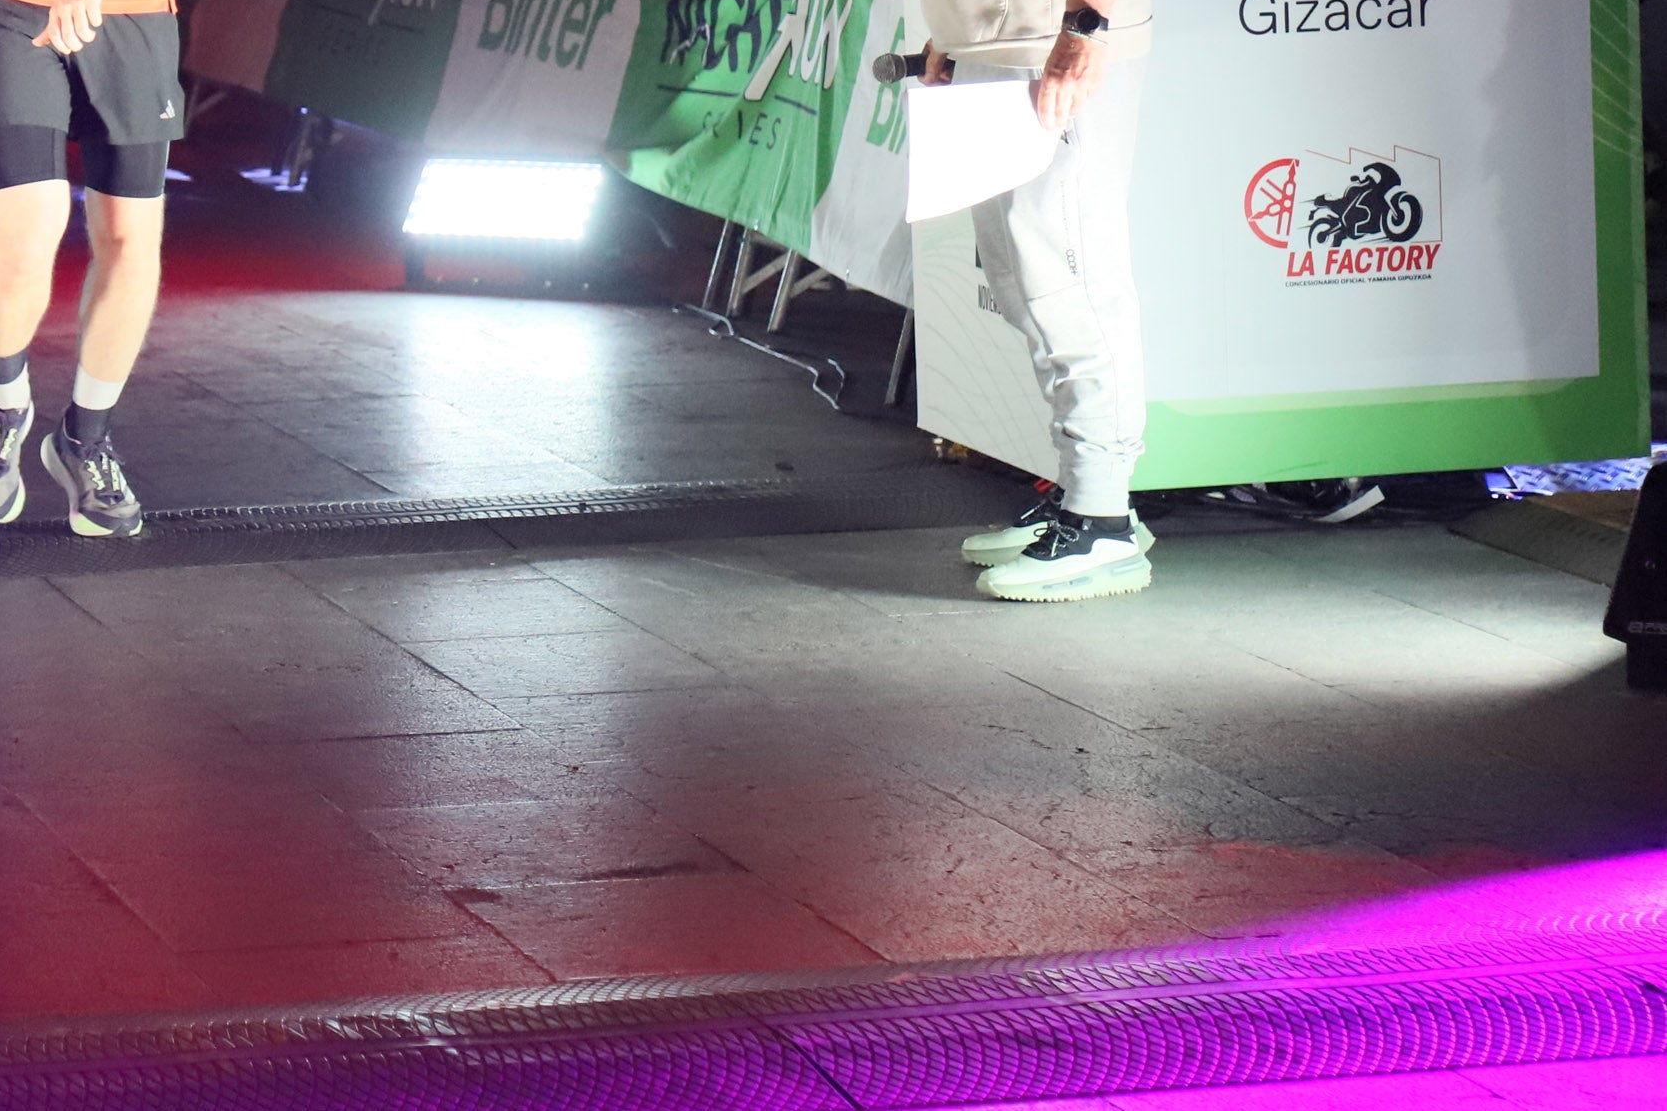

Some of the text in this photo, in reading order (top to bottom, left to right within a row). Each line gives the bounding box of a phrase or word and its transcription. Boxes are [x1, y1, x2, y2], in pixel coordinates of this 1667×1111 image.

[1287, 243, 1442, 277] LA FACTORY
[1285, 278, 1340, 288] CONCESIONARIO
[1341, 277, 1366, 285] OFICIAL
[1367, 275, 1396, 283] YAMAHA
